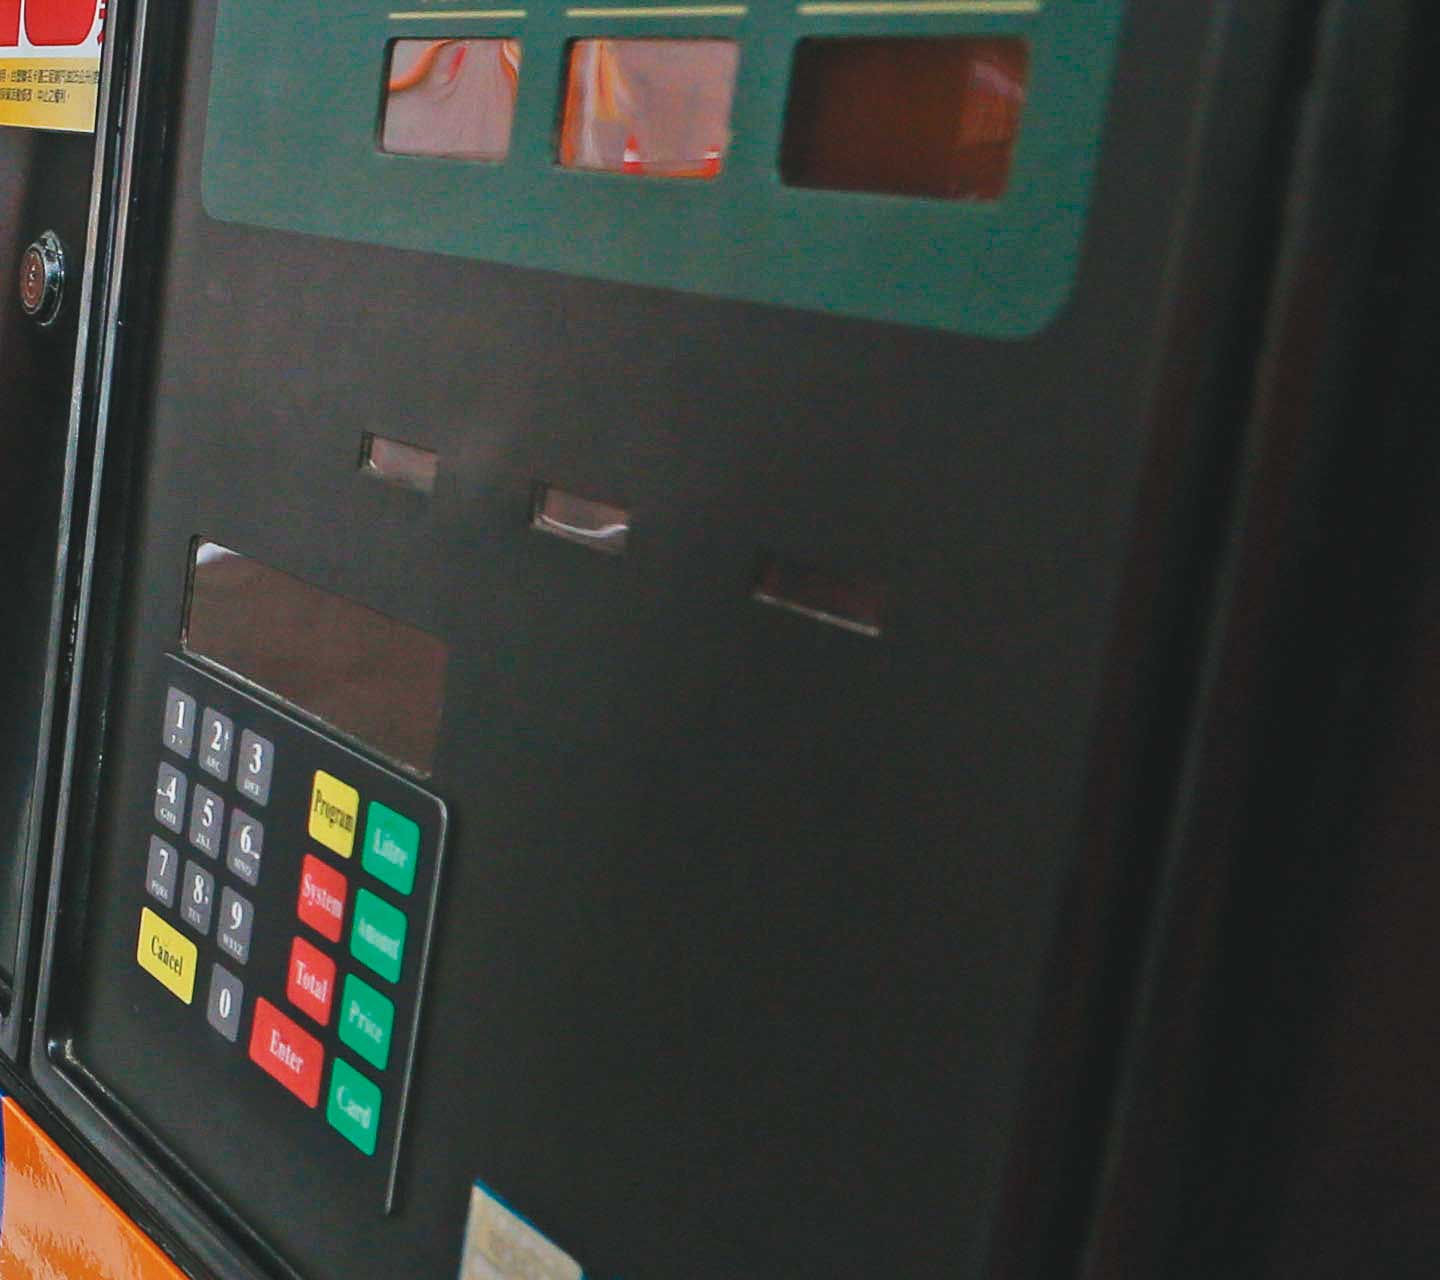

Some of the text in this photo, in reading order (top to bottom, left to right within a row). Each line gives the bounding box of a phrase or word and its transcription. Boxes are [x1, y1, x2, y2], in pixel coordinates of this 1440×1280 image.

[176, 701, 185, 730] 1
[212, 719, 224, 751] 2
[248, 743, 263, 774] 3
[164, 776, 178, 805] 4
[201, 798, 214, 829] 5
[313, 789, 355, 833] Program
[239, 825, 252, 855] 6
[159, 847, 169, 877] 7
[192, 873, 205, 905] 8
[303, 872, 345, 921] System
[231, 901, 243, 931] 9
[151, 933, 184, 977] Cancel
[295, 959, 329, 1004] Total
[218, 987, 231, 1020] 0
[347, 998, 385, 1045] Price
[268, 1027, 305, 1076] Enter
[336, 1084, 373, 1130] Card
